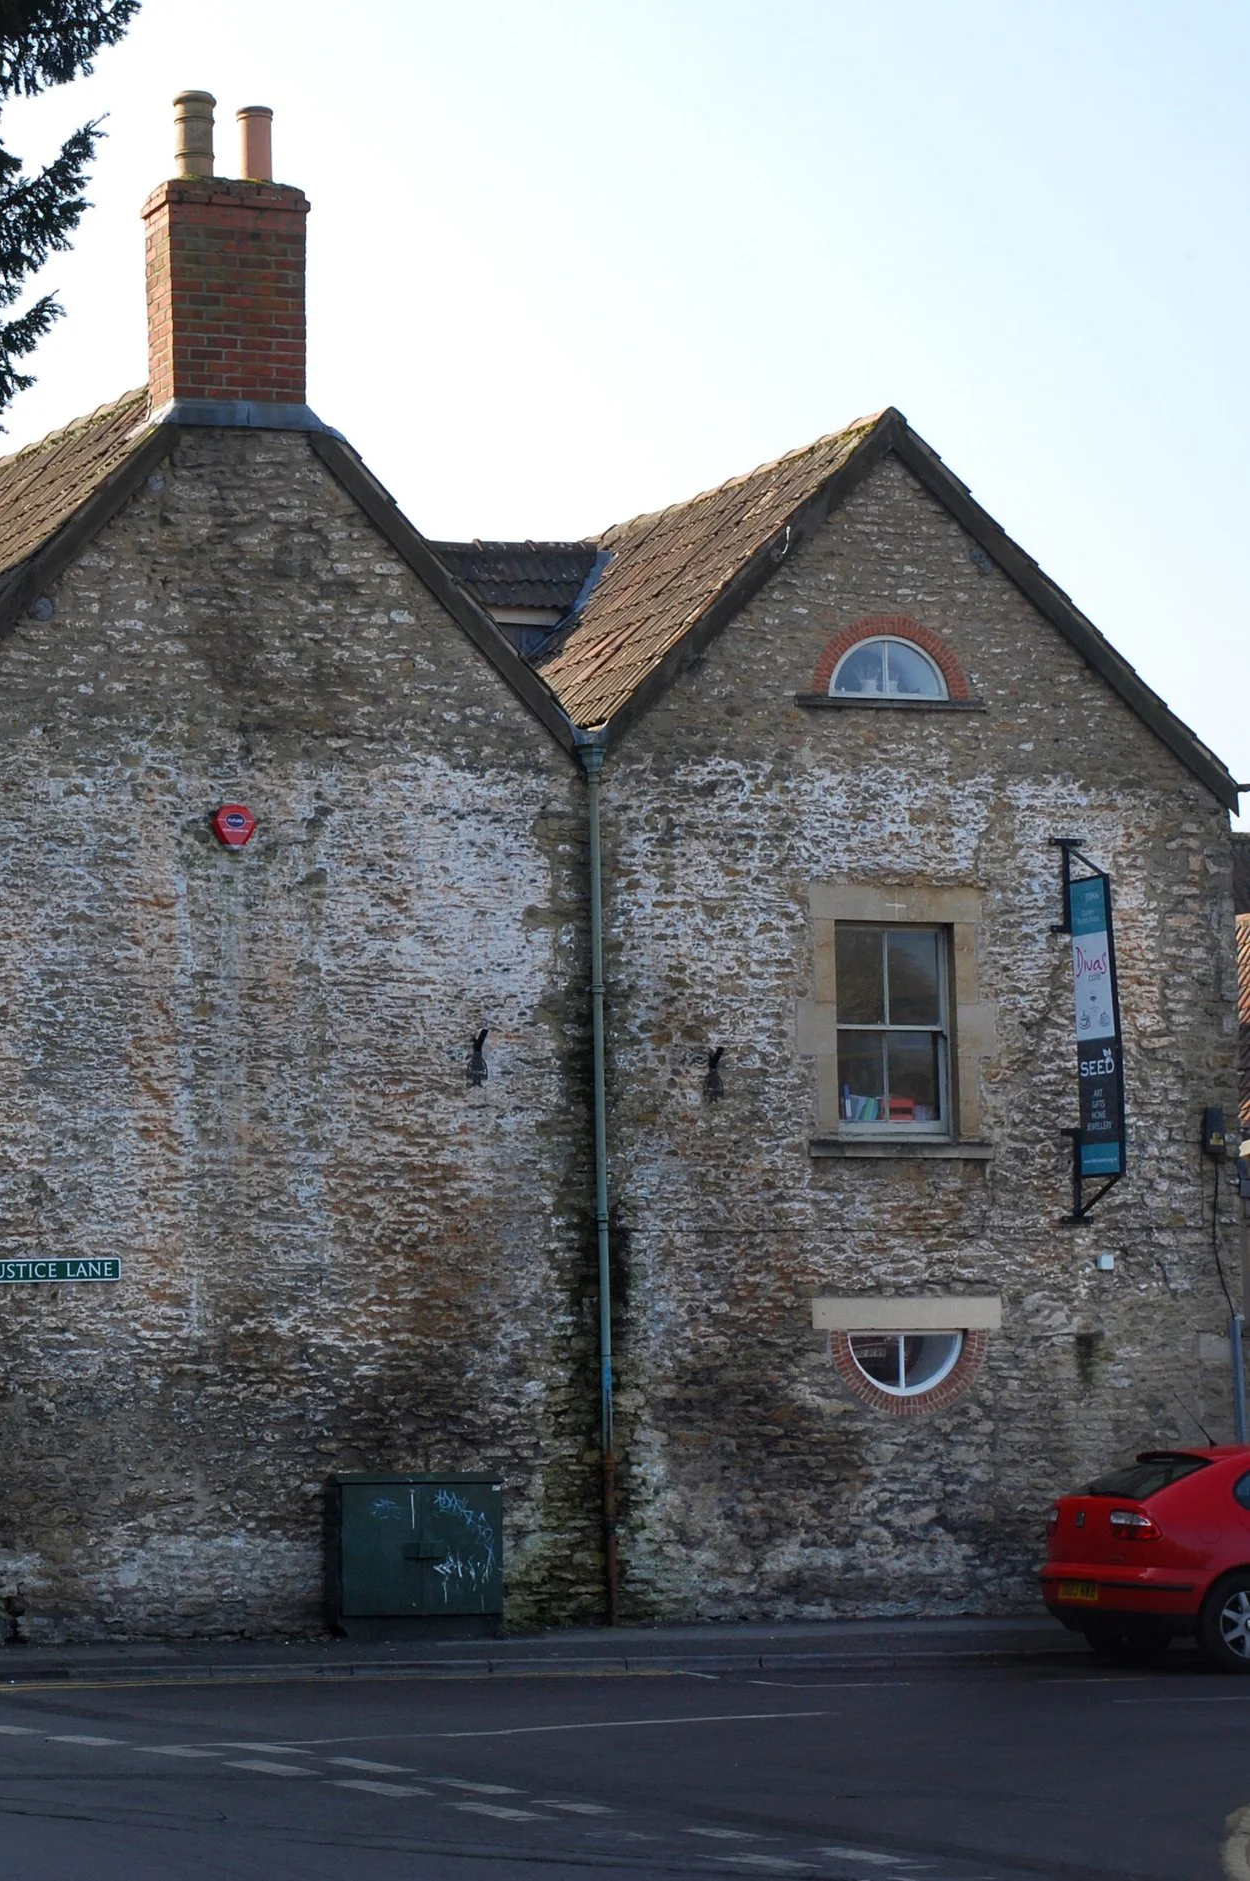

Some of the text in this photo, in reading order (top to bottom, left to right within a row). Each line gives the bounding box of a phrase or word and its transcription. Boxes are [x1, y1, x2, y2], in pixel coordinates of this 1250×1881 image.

[1075, 946, 1107, 977] Divas
[1080, 1059, 1115, 1077] SEED
[66, 1261, 113, 1278] LANE
